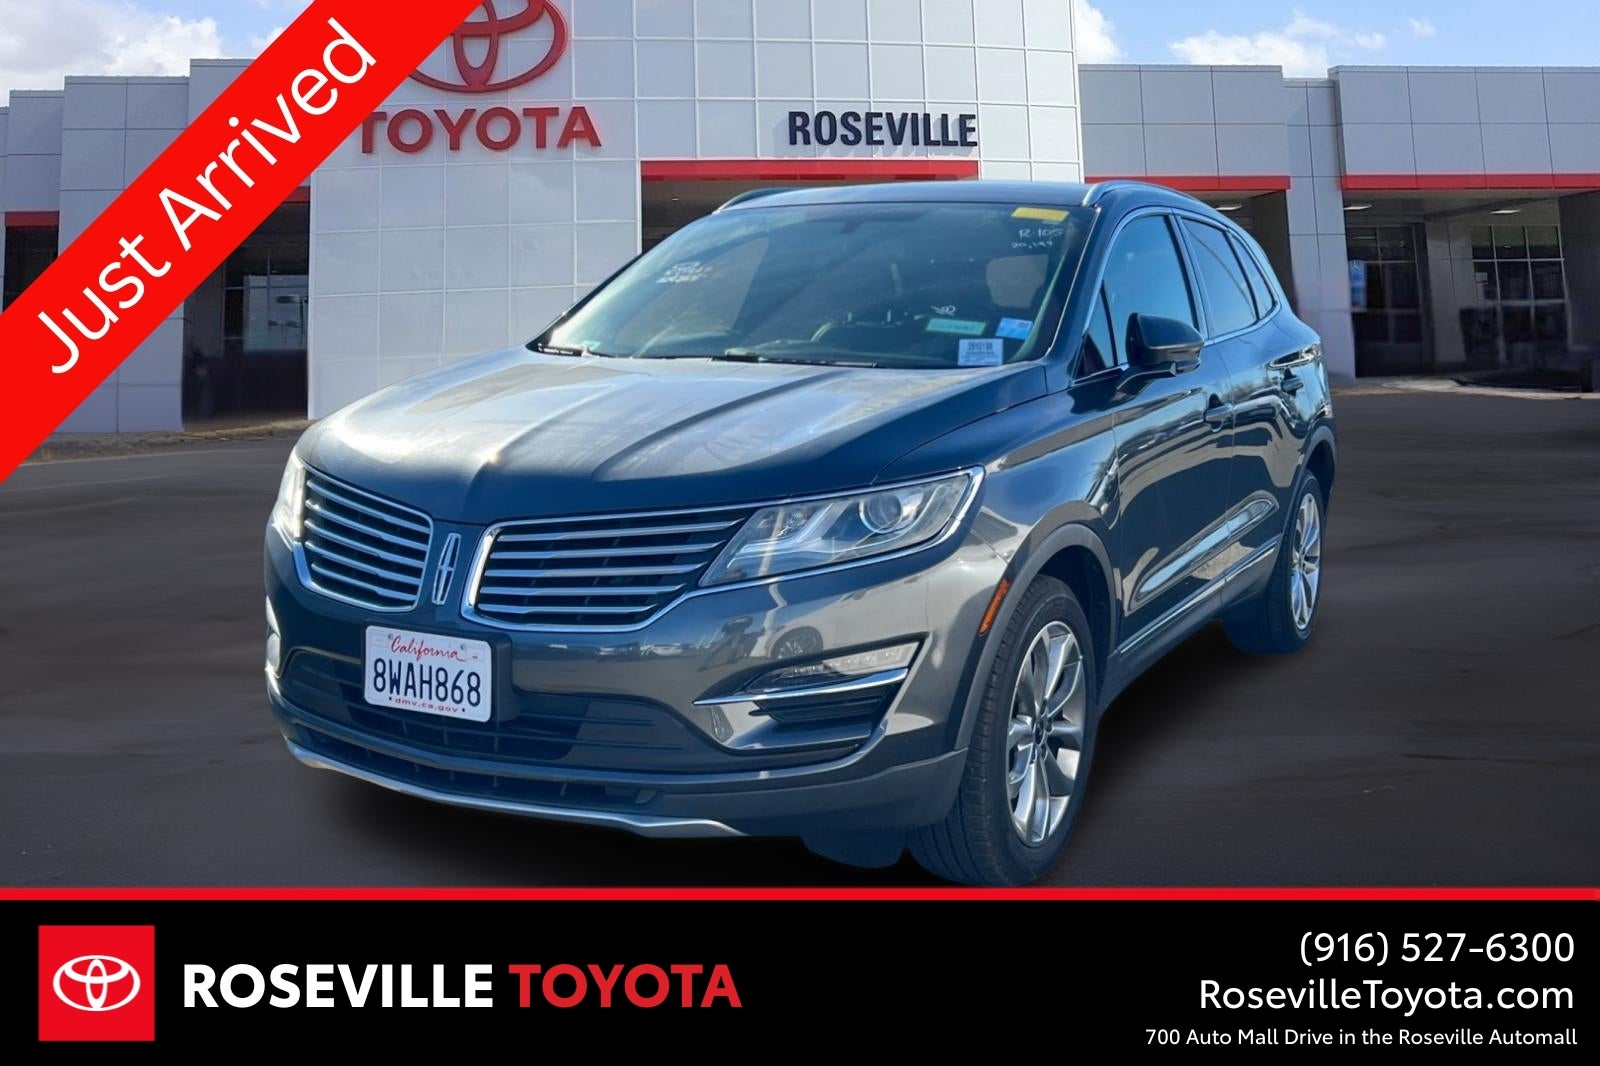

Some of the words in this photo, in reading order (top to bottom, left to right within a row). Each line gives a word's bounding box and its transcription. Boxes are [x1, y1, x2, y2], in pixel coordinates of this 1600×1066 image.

[361, 106, 602, 154] TOYOTA
[788, 110, 978, 148] ROSEVILLE
[391, 635, 466, 661] California
[373, 658, 481, 707] 8WAH868
[394, 697, 458, 712] dmv.ca.gov
